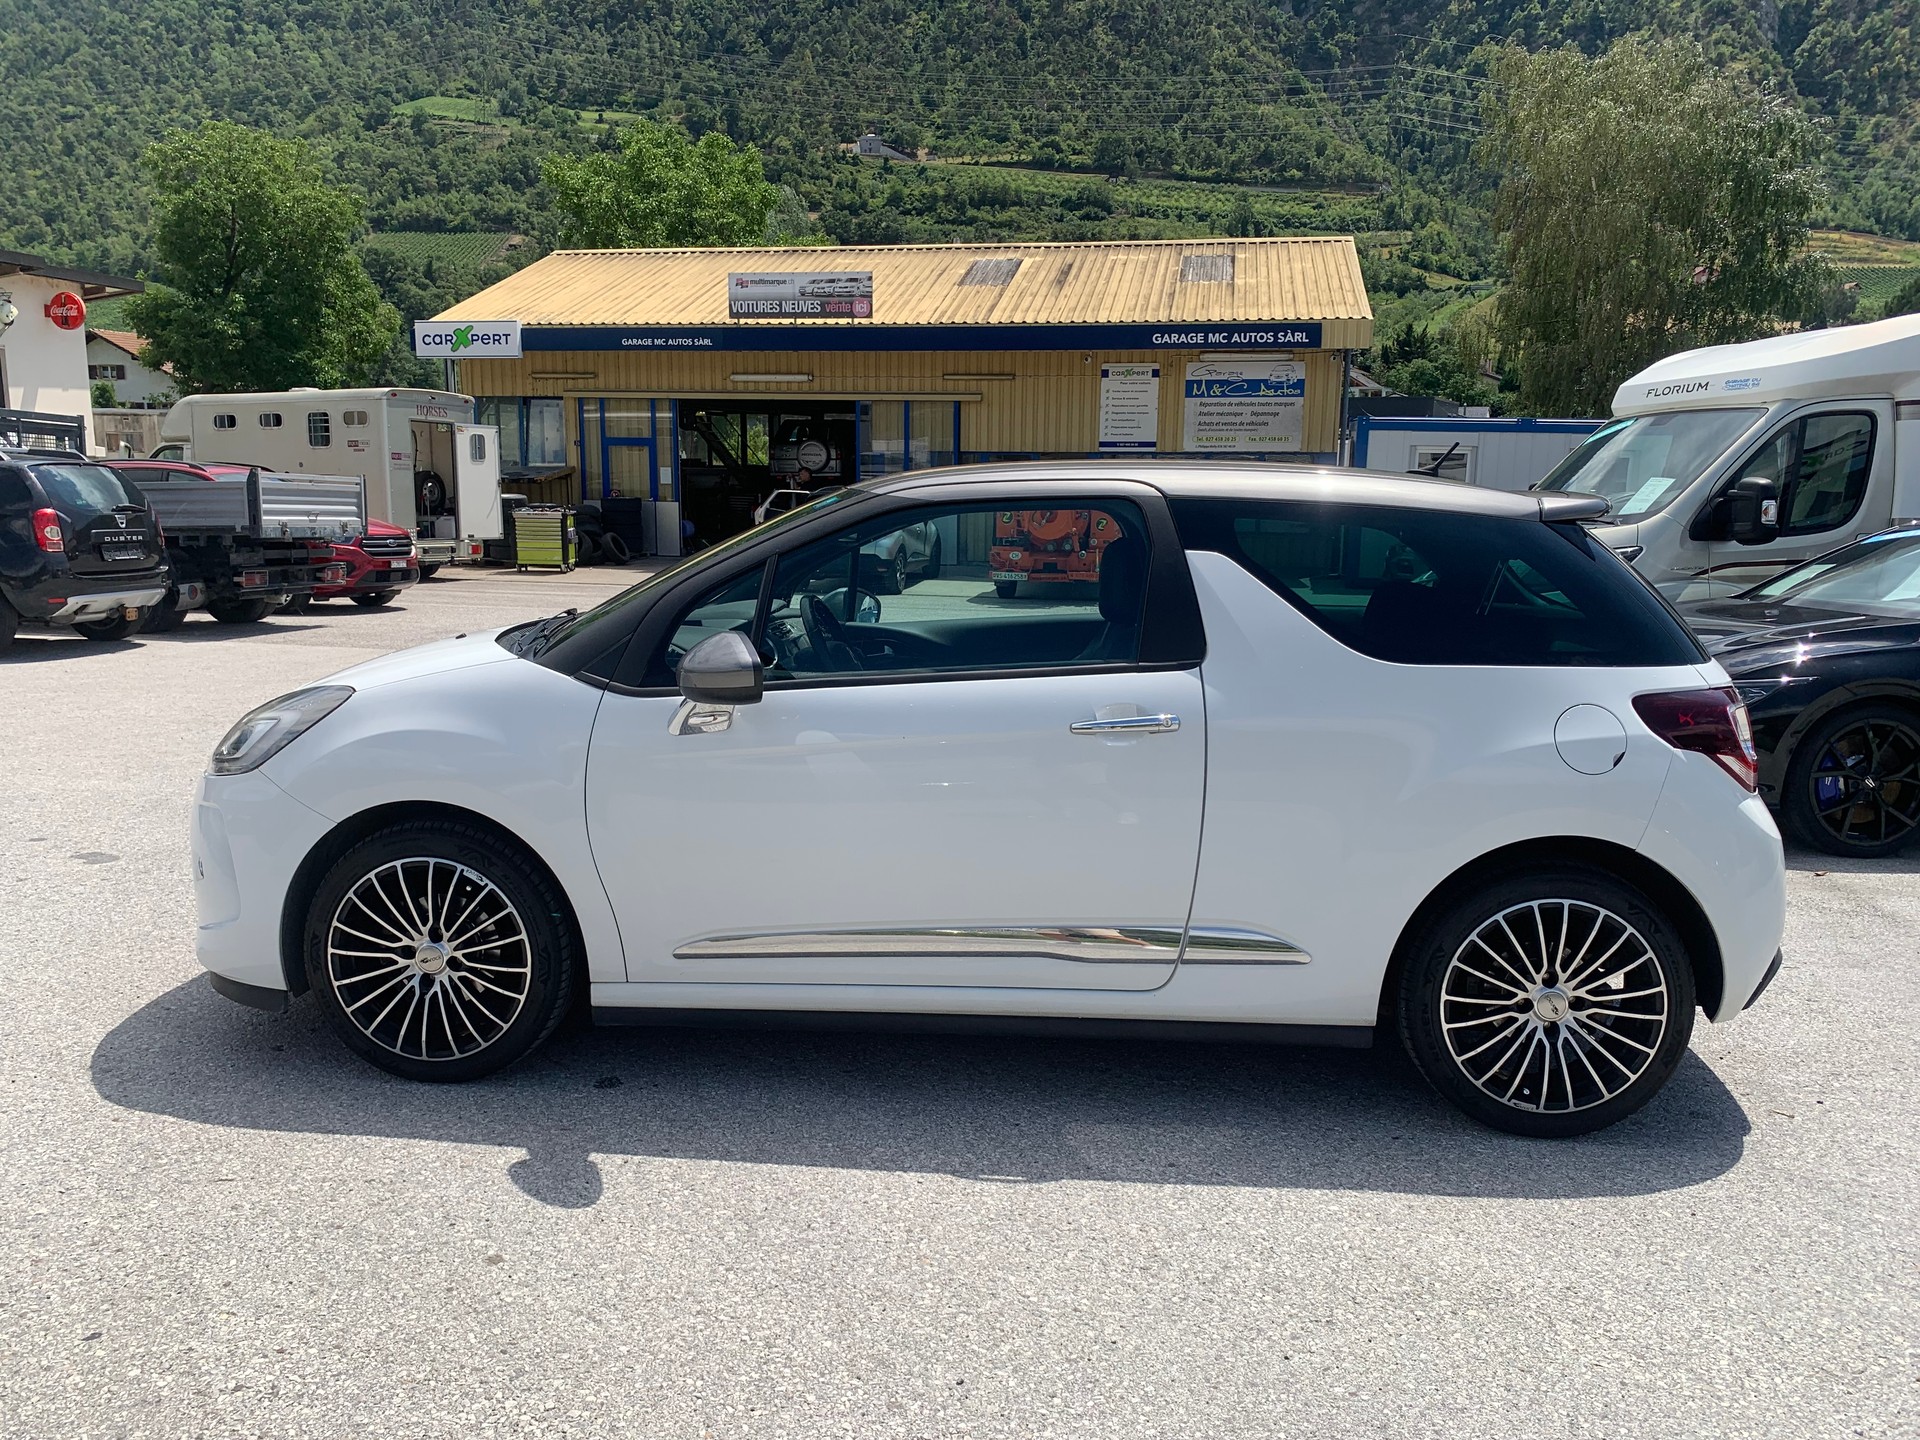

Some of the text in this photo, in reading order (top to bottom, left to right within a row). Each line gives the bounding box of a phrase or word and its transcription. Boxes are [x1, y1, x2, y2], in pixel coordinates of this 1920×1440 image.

[731, 300, 821, 313] VOITURES NEUVES
[825, 300, 867, 313] vente ici
[621, 338, 653, 346] GARAGE
[654, 338, 667, 346] MC
[667, 338, 693, 346] AUTOS
[1152, 329, 1310, 344] GARAGE MC AUTOS SÀRL
[1193, 379, 1208, 397] M
[1646, 381, 1710, 398] FLORIUM
[416, 404, 448, 418] HORSES
[1199, 401, 1227, 409] Réparation
[1234, 400, 1257, 408] véhicules
[1257, 400, 1273, 408] toutes
[1273, 401, 1296, 409] marques
[1216, 410, 1244, 418] mécanique
[1250, 410, 1280, 418] Dépannage
[1197, 420, 1215, 428] Achats
[1221, 420, 1238, 428] ventes
